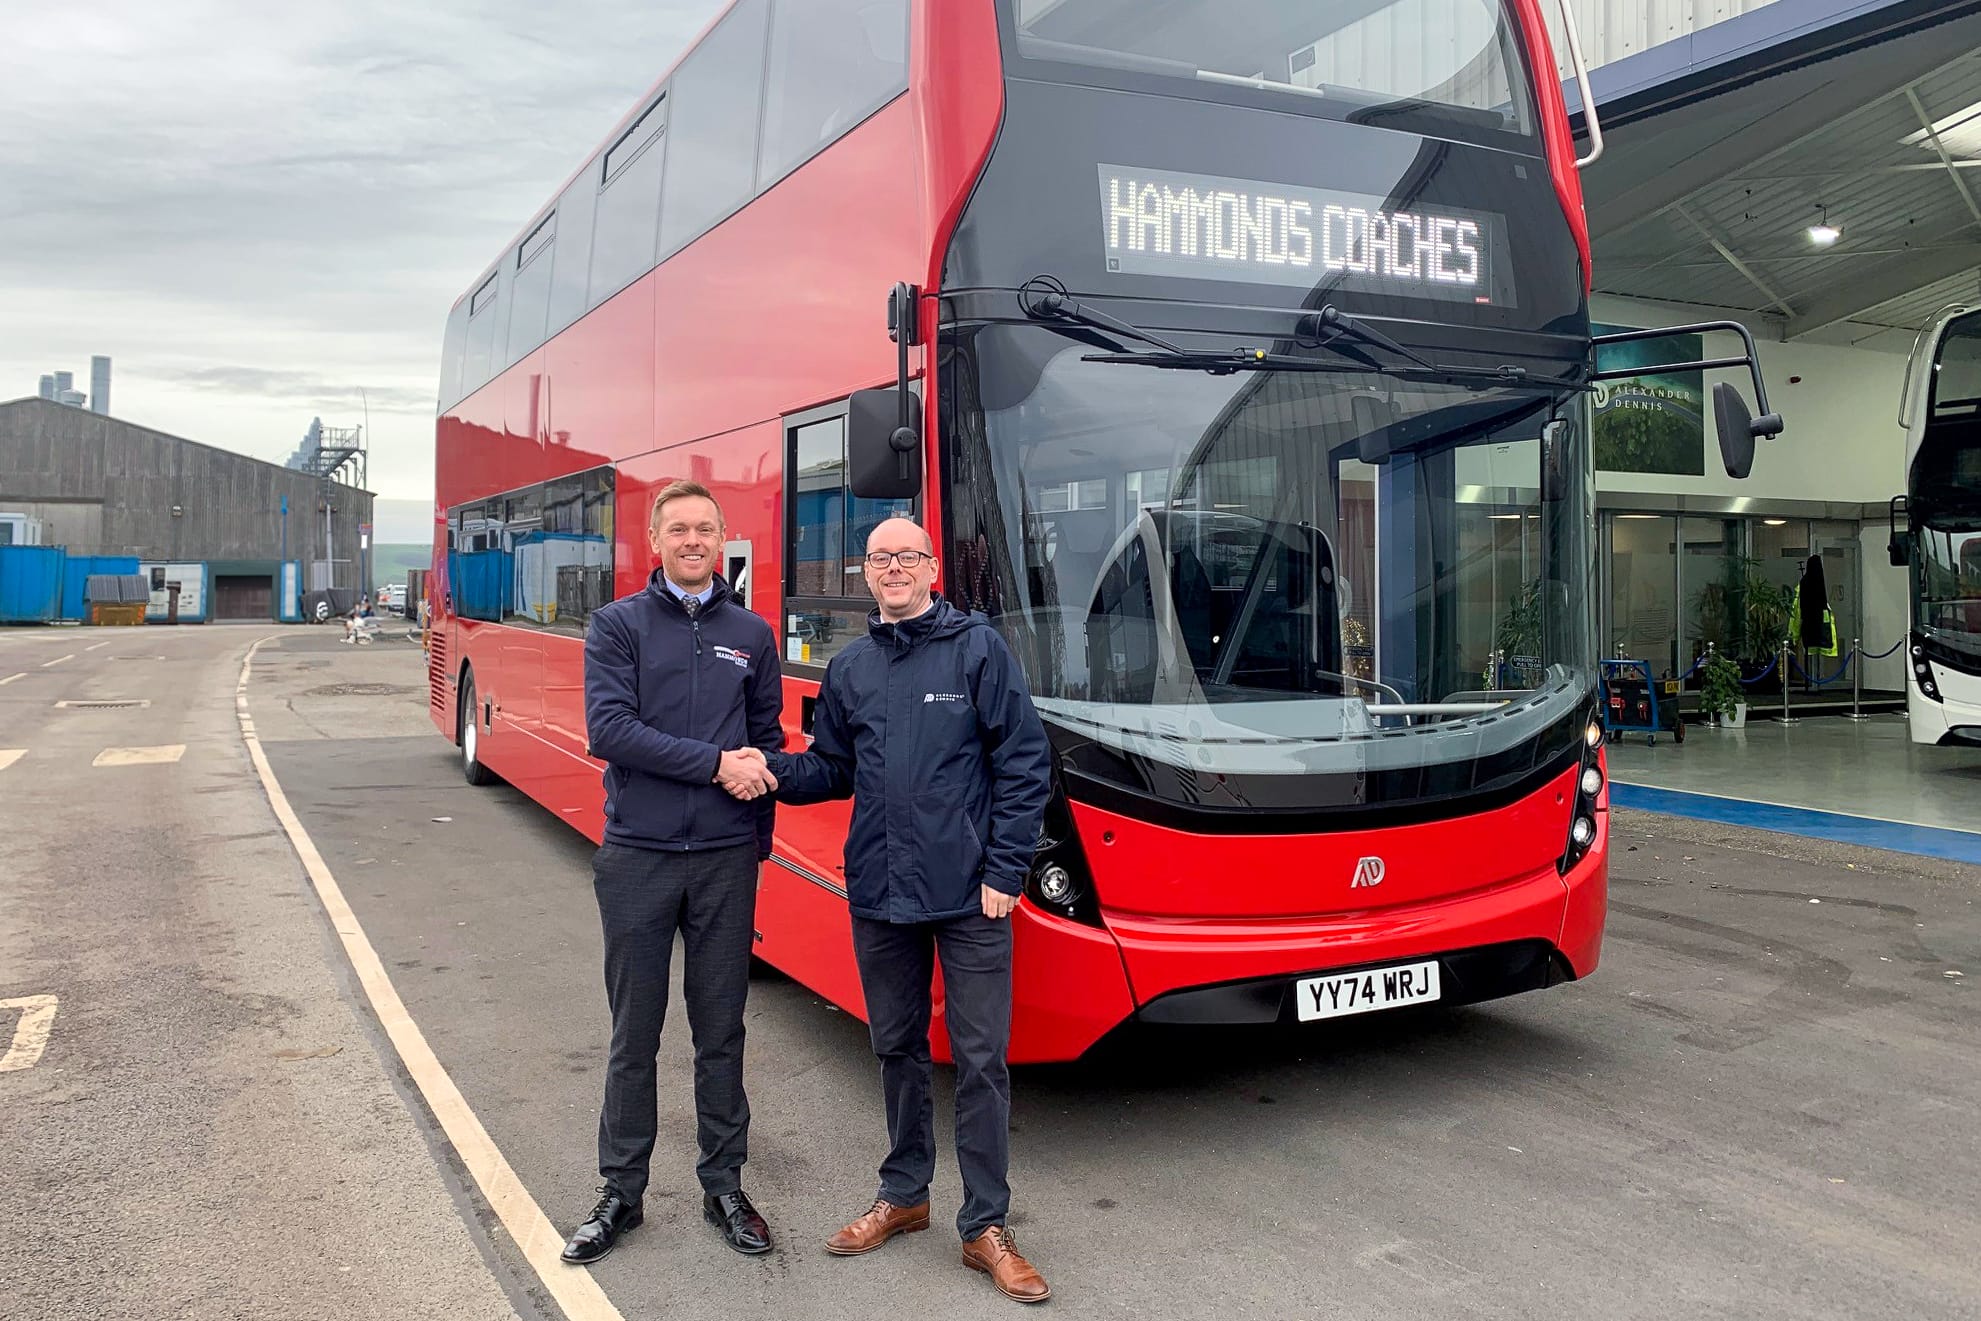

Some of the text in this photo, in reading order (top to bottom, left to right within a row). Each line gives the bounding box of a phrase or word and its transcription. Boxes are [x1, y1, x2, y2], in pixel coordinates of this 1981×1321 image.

[1110, 178, 1479, 284] HAMMONDS COACHES
[1615, 385, 1690, 400] ALEXANDER
[1615, 399, 1662, 411] DENNIS
[1309, 966, 1429, 1012] YY74 WRJ
